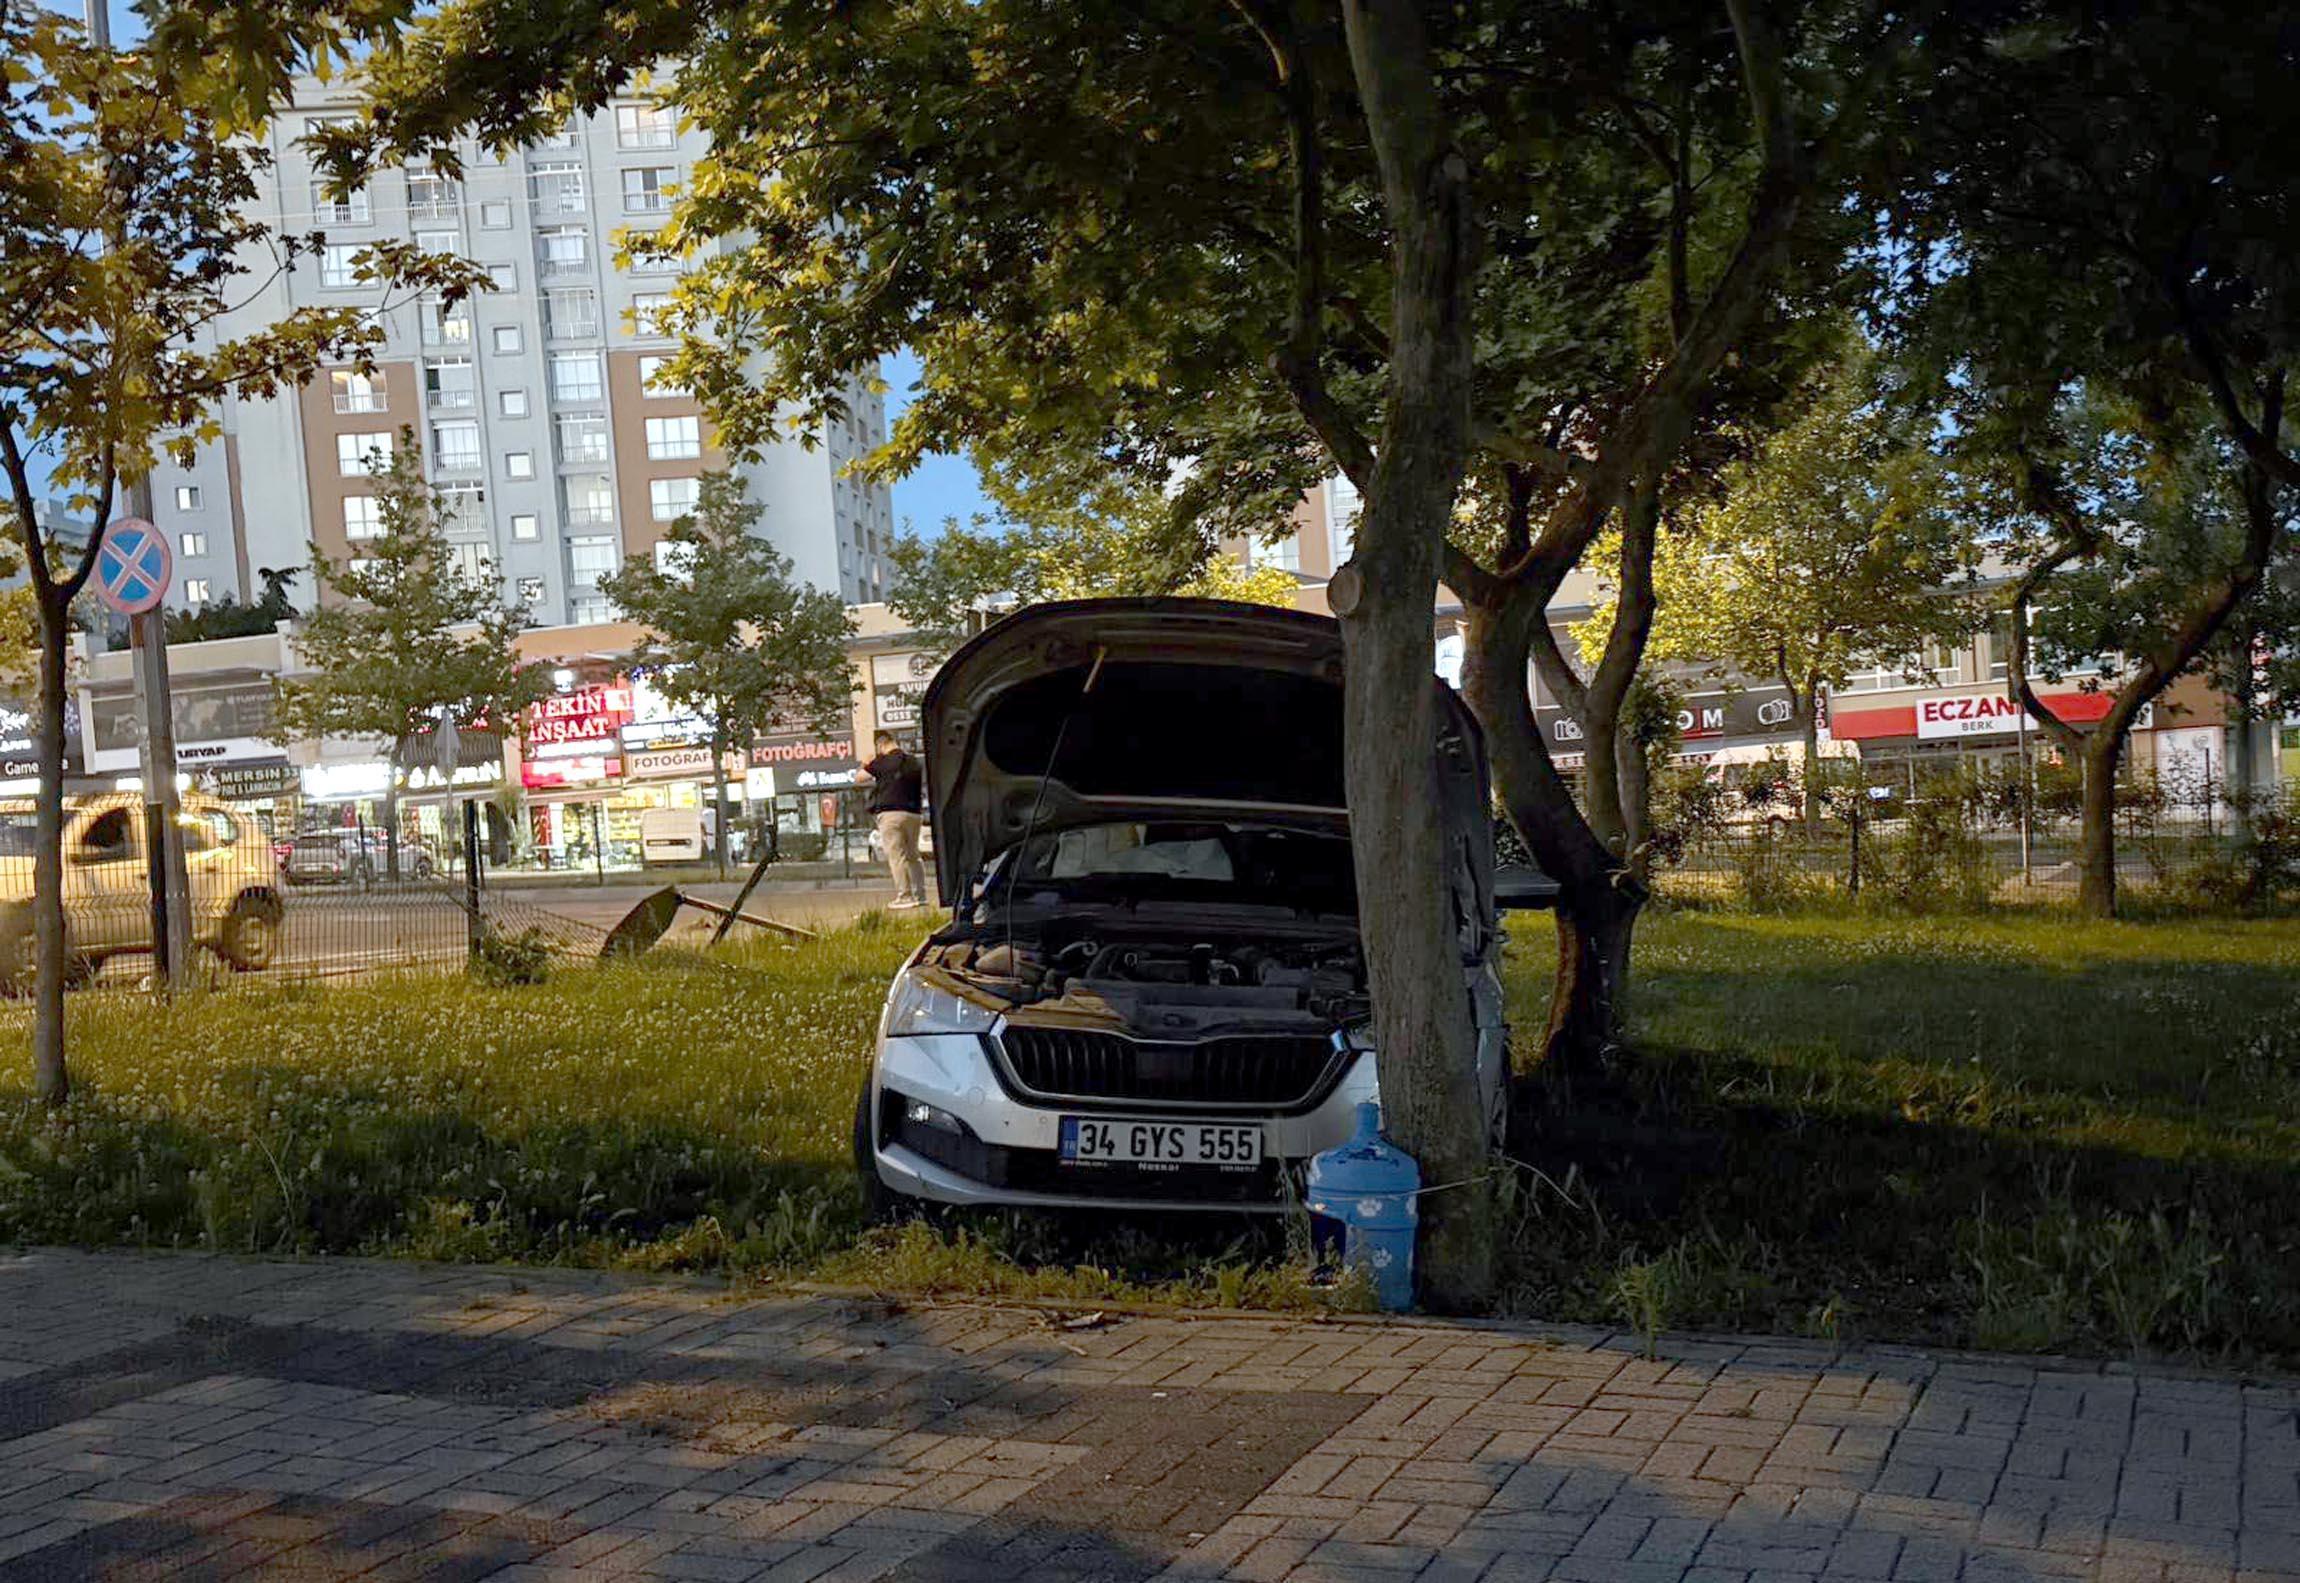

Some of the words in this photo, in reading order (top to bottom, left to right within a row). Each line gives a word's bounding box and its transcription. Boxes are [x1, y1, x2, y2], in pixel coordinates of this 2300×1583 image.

[1923, 696, 2019, 722] ECZAN
[1961, 720, 1994, 731] BERK
[634, 750, 728, 769] FOTOĞRAF
[752, 740, 853, 763] FOTOĞRAFÇI
[1080, 1123, 1115, 1157] 34
[1130, 1126, 1186, 1159] GYS
[1199, 1128, 1252, 1161] 555
